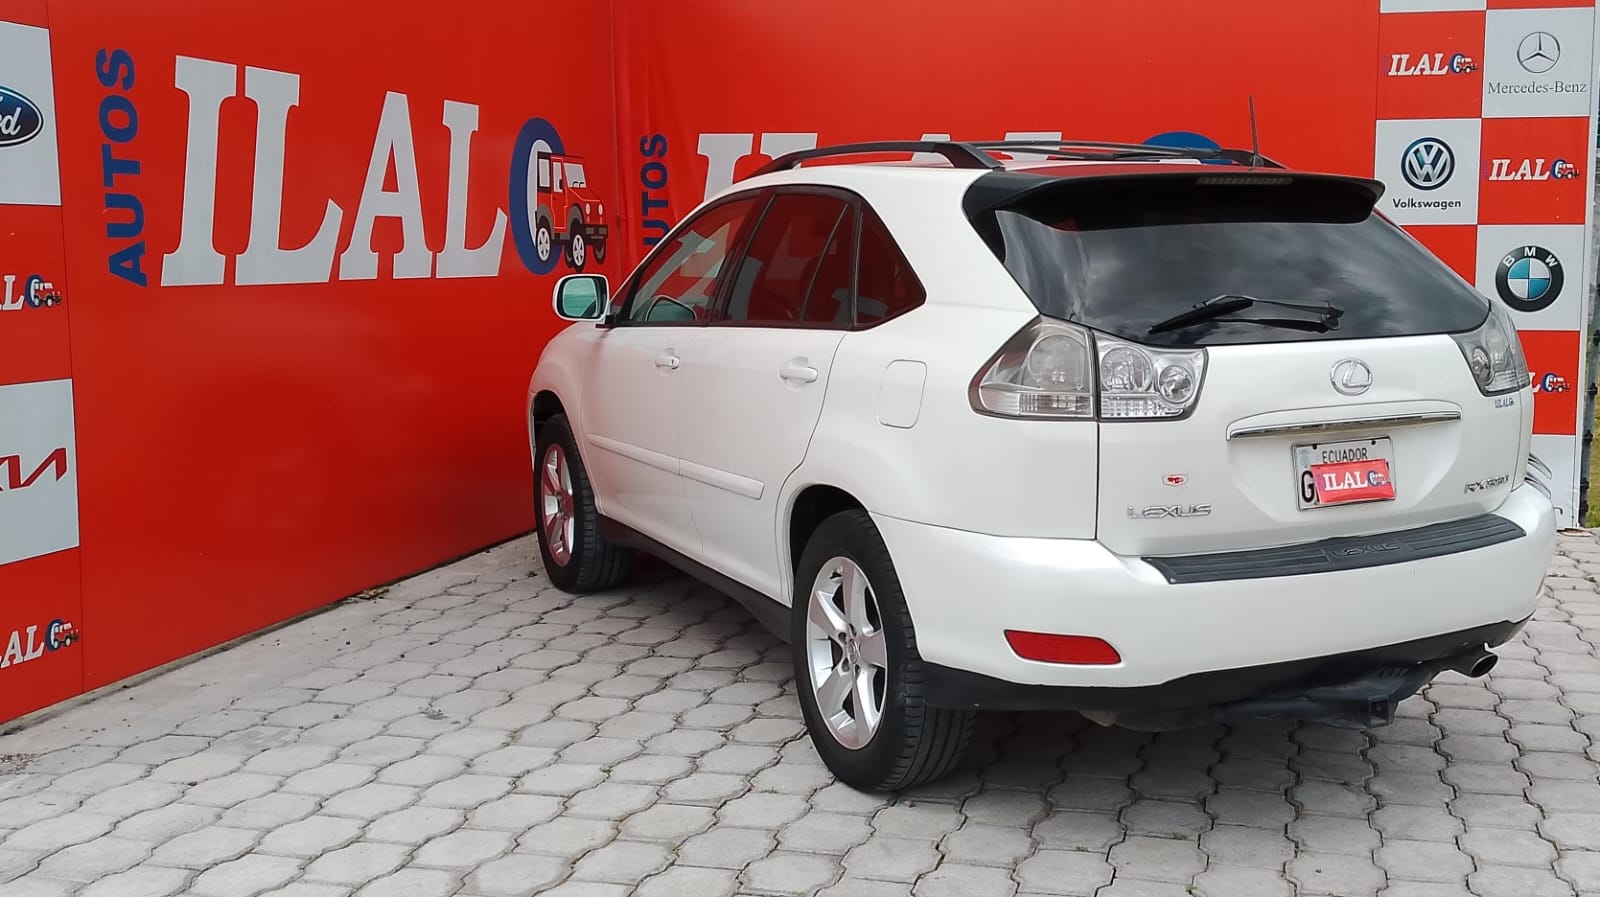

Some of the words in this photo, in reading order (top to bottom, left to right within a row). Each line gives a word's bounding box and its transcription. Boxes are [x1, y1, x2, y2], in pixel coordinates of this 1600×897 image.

[1487, 80, 1587, 95] Mercedes-Benz
[95, 48, 147, 288] AUTOS
[1393, 198, 1462, 211] Volkswagen
[1502, 246, 1558, 268] BMW
[1322, 447, 1368, 464] ECUADOR
[1127, 503, 1212, 519] LEXUS
